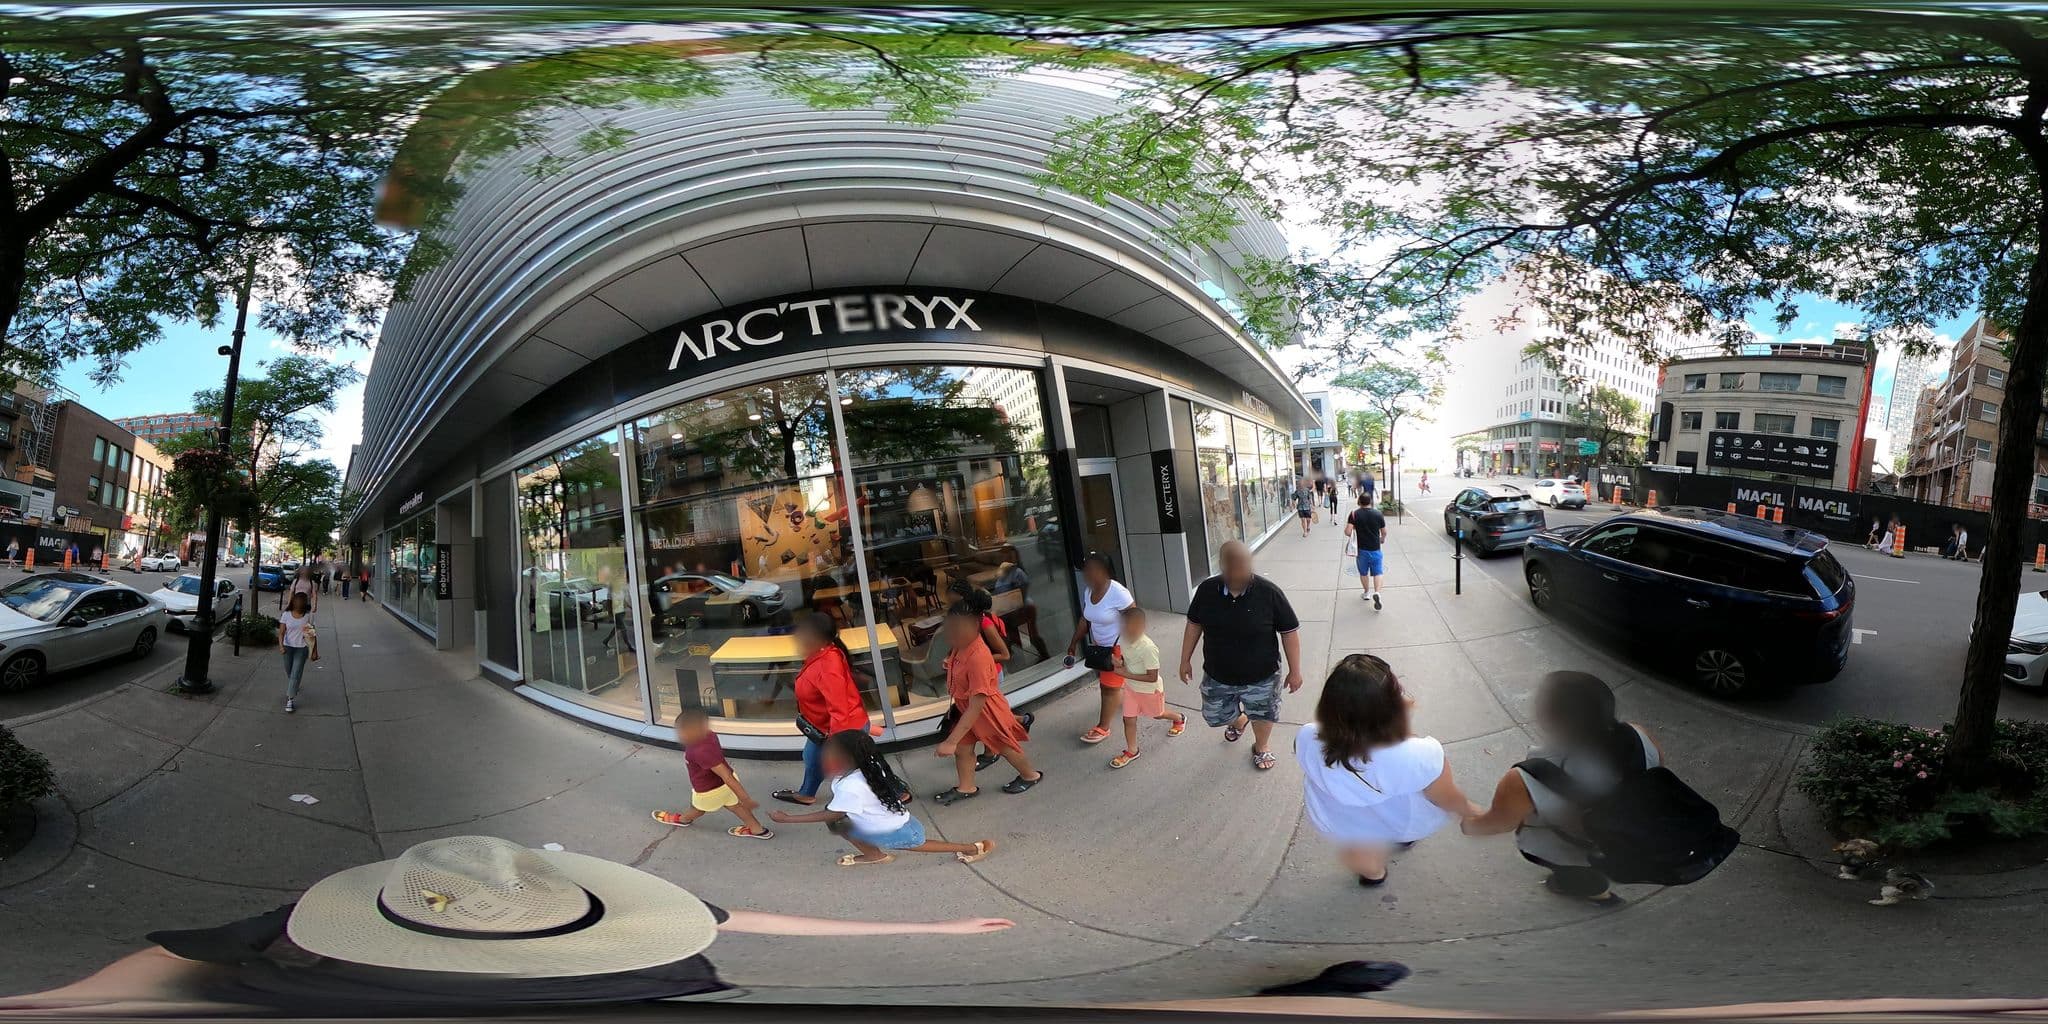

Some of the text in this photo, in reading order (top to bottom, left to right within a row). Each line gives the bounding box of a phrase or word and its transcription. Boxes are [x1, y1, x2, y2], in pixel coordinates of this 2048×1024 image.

[668, 294, 983, 371] ARC'TERYX
[1737, 488, 1785, 506] MAGIL
[1799, 496, 1851, 516] MAGIL
[439, 550, 447, 595] icebreaker
